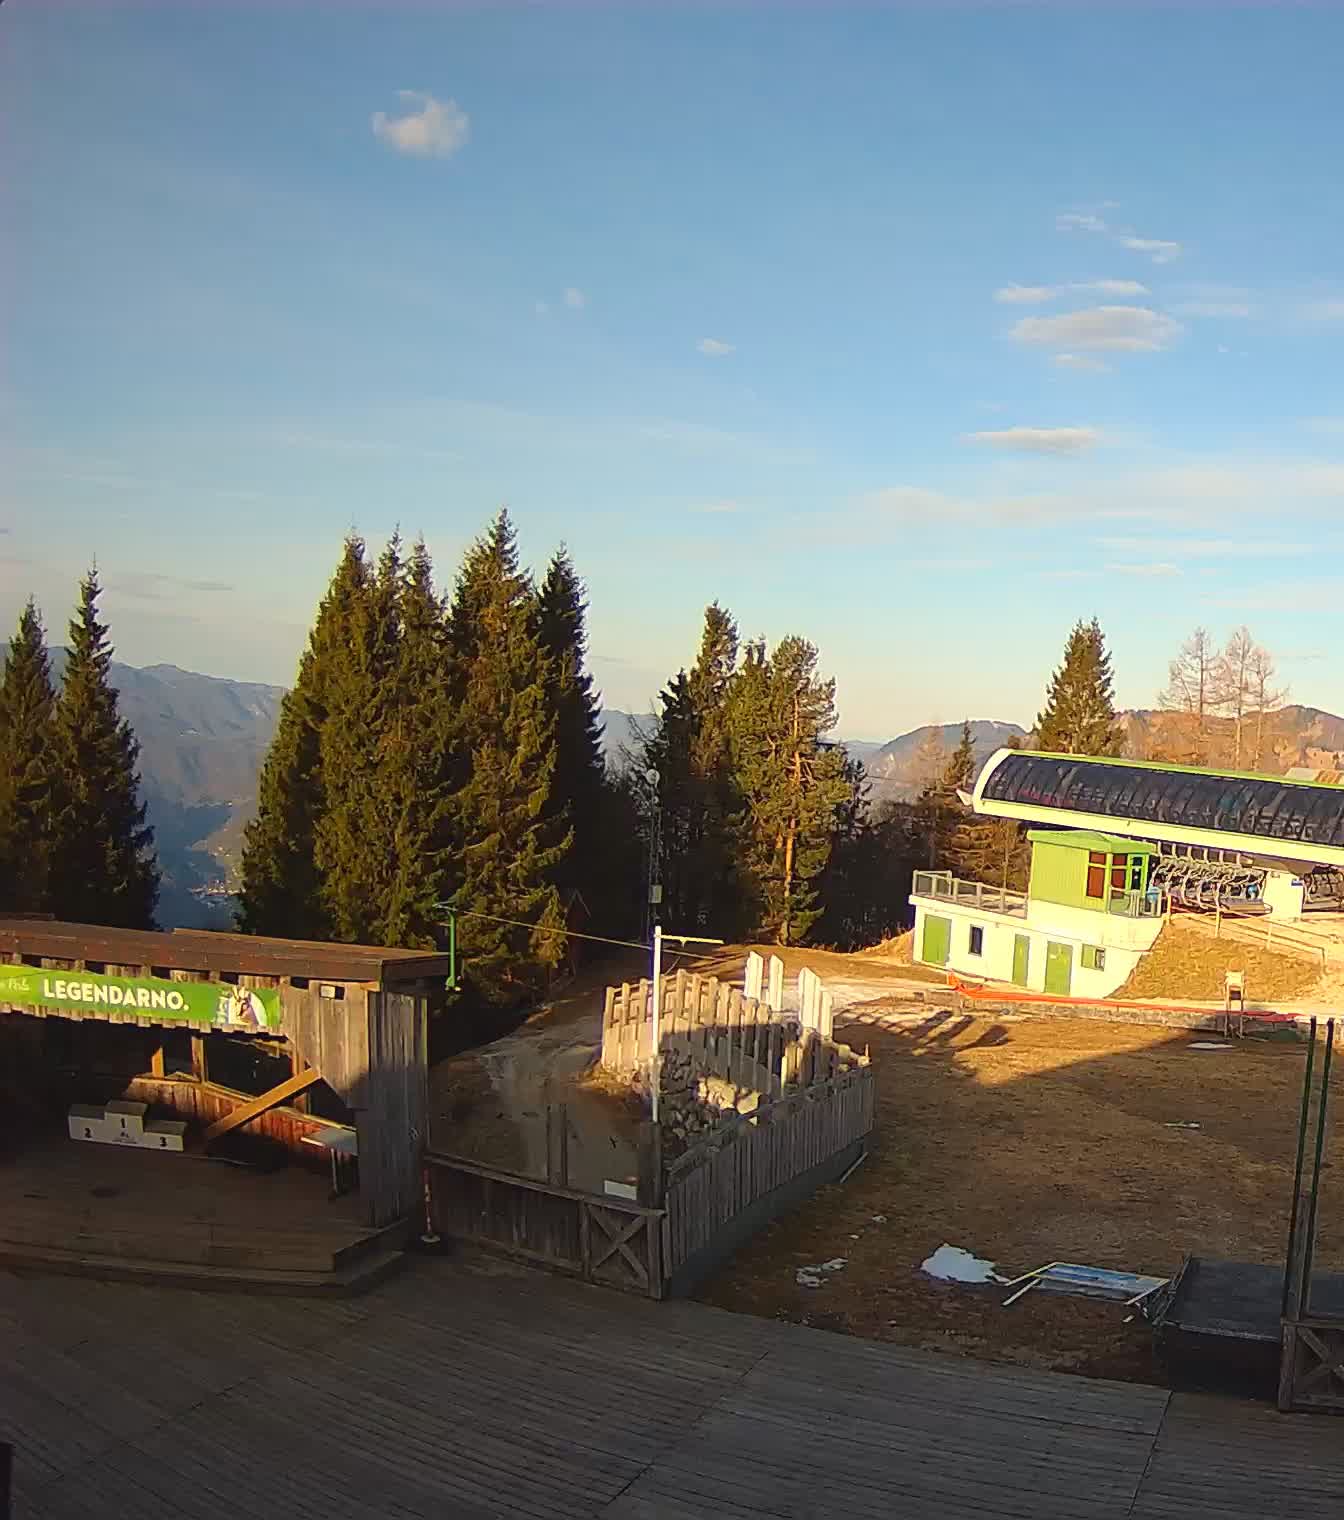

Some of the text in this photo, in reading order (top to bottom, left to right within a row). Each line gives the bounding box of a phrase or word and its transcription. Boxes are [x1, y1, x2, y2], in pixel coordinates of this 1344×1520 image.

[43, 979, 189, 1011] LEGENDARNO.
[121, 1117, 126, 1129] 1
[84, 1127, 92, 1139] 2
[160, 1136, 167, 1147] 3
